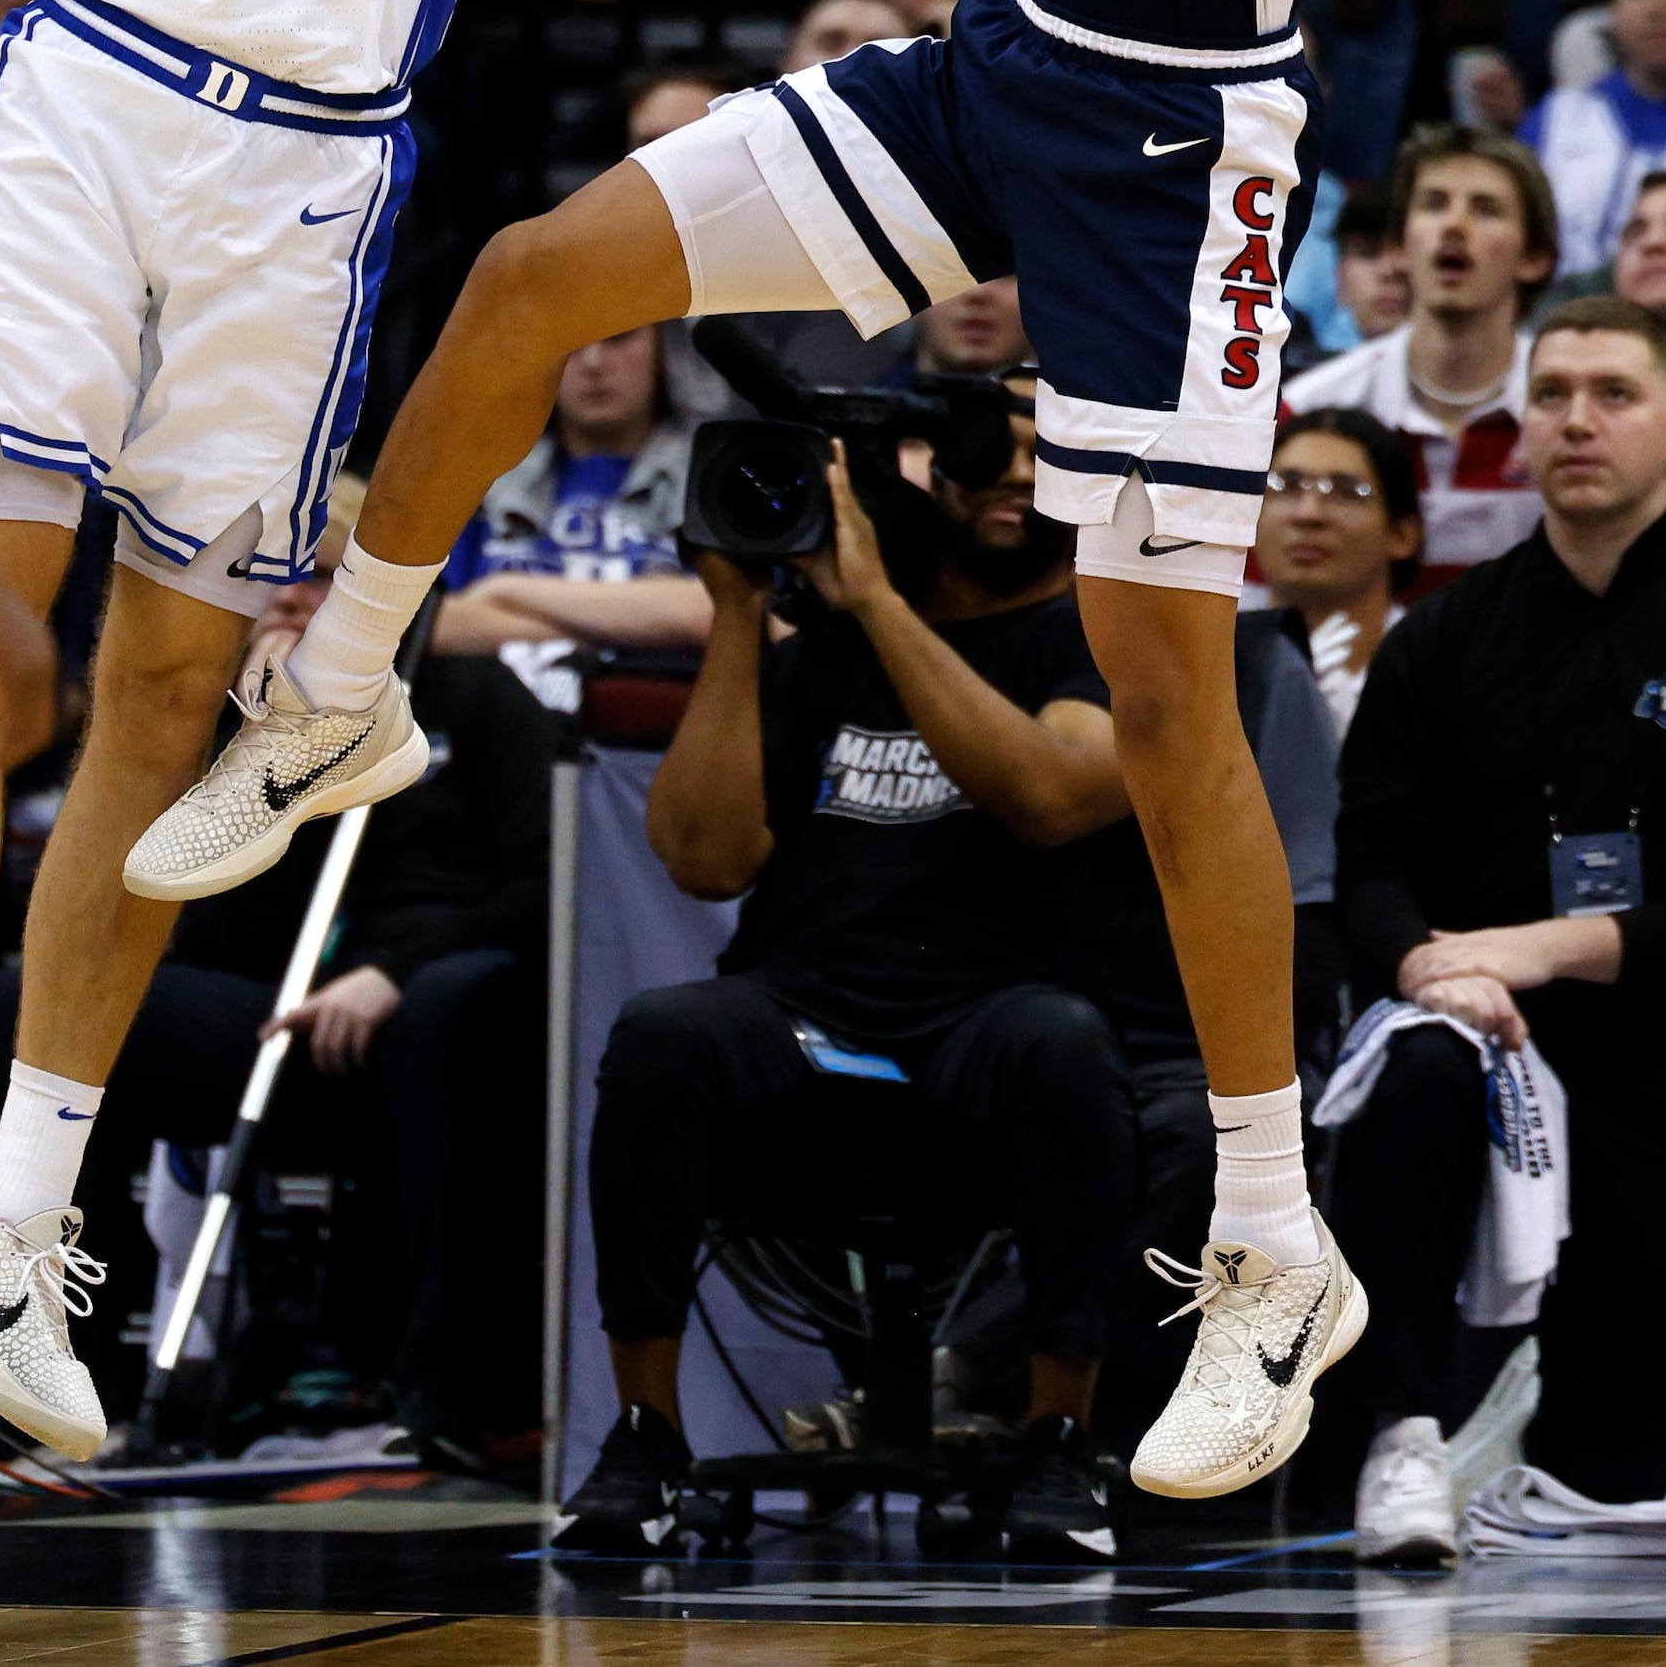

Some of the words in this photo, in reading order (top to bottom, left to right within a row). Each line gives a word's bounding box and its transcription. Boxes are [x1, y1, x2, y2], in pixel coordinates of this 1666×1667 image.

[196, 60, 252, 113] D
[1219, 176, 1279, 390] CATS
[839, 769, 961, 810] MADN
